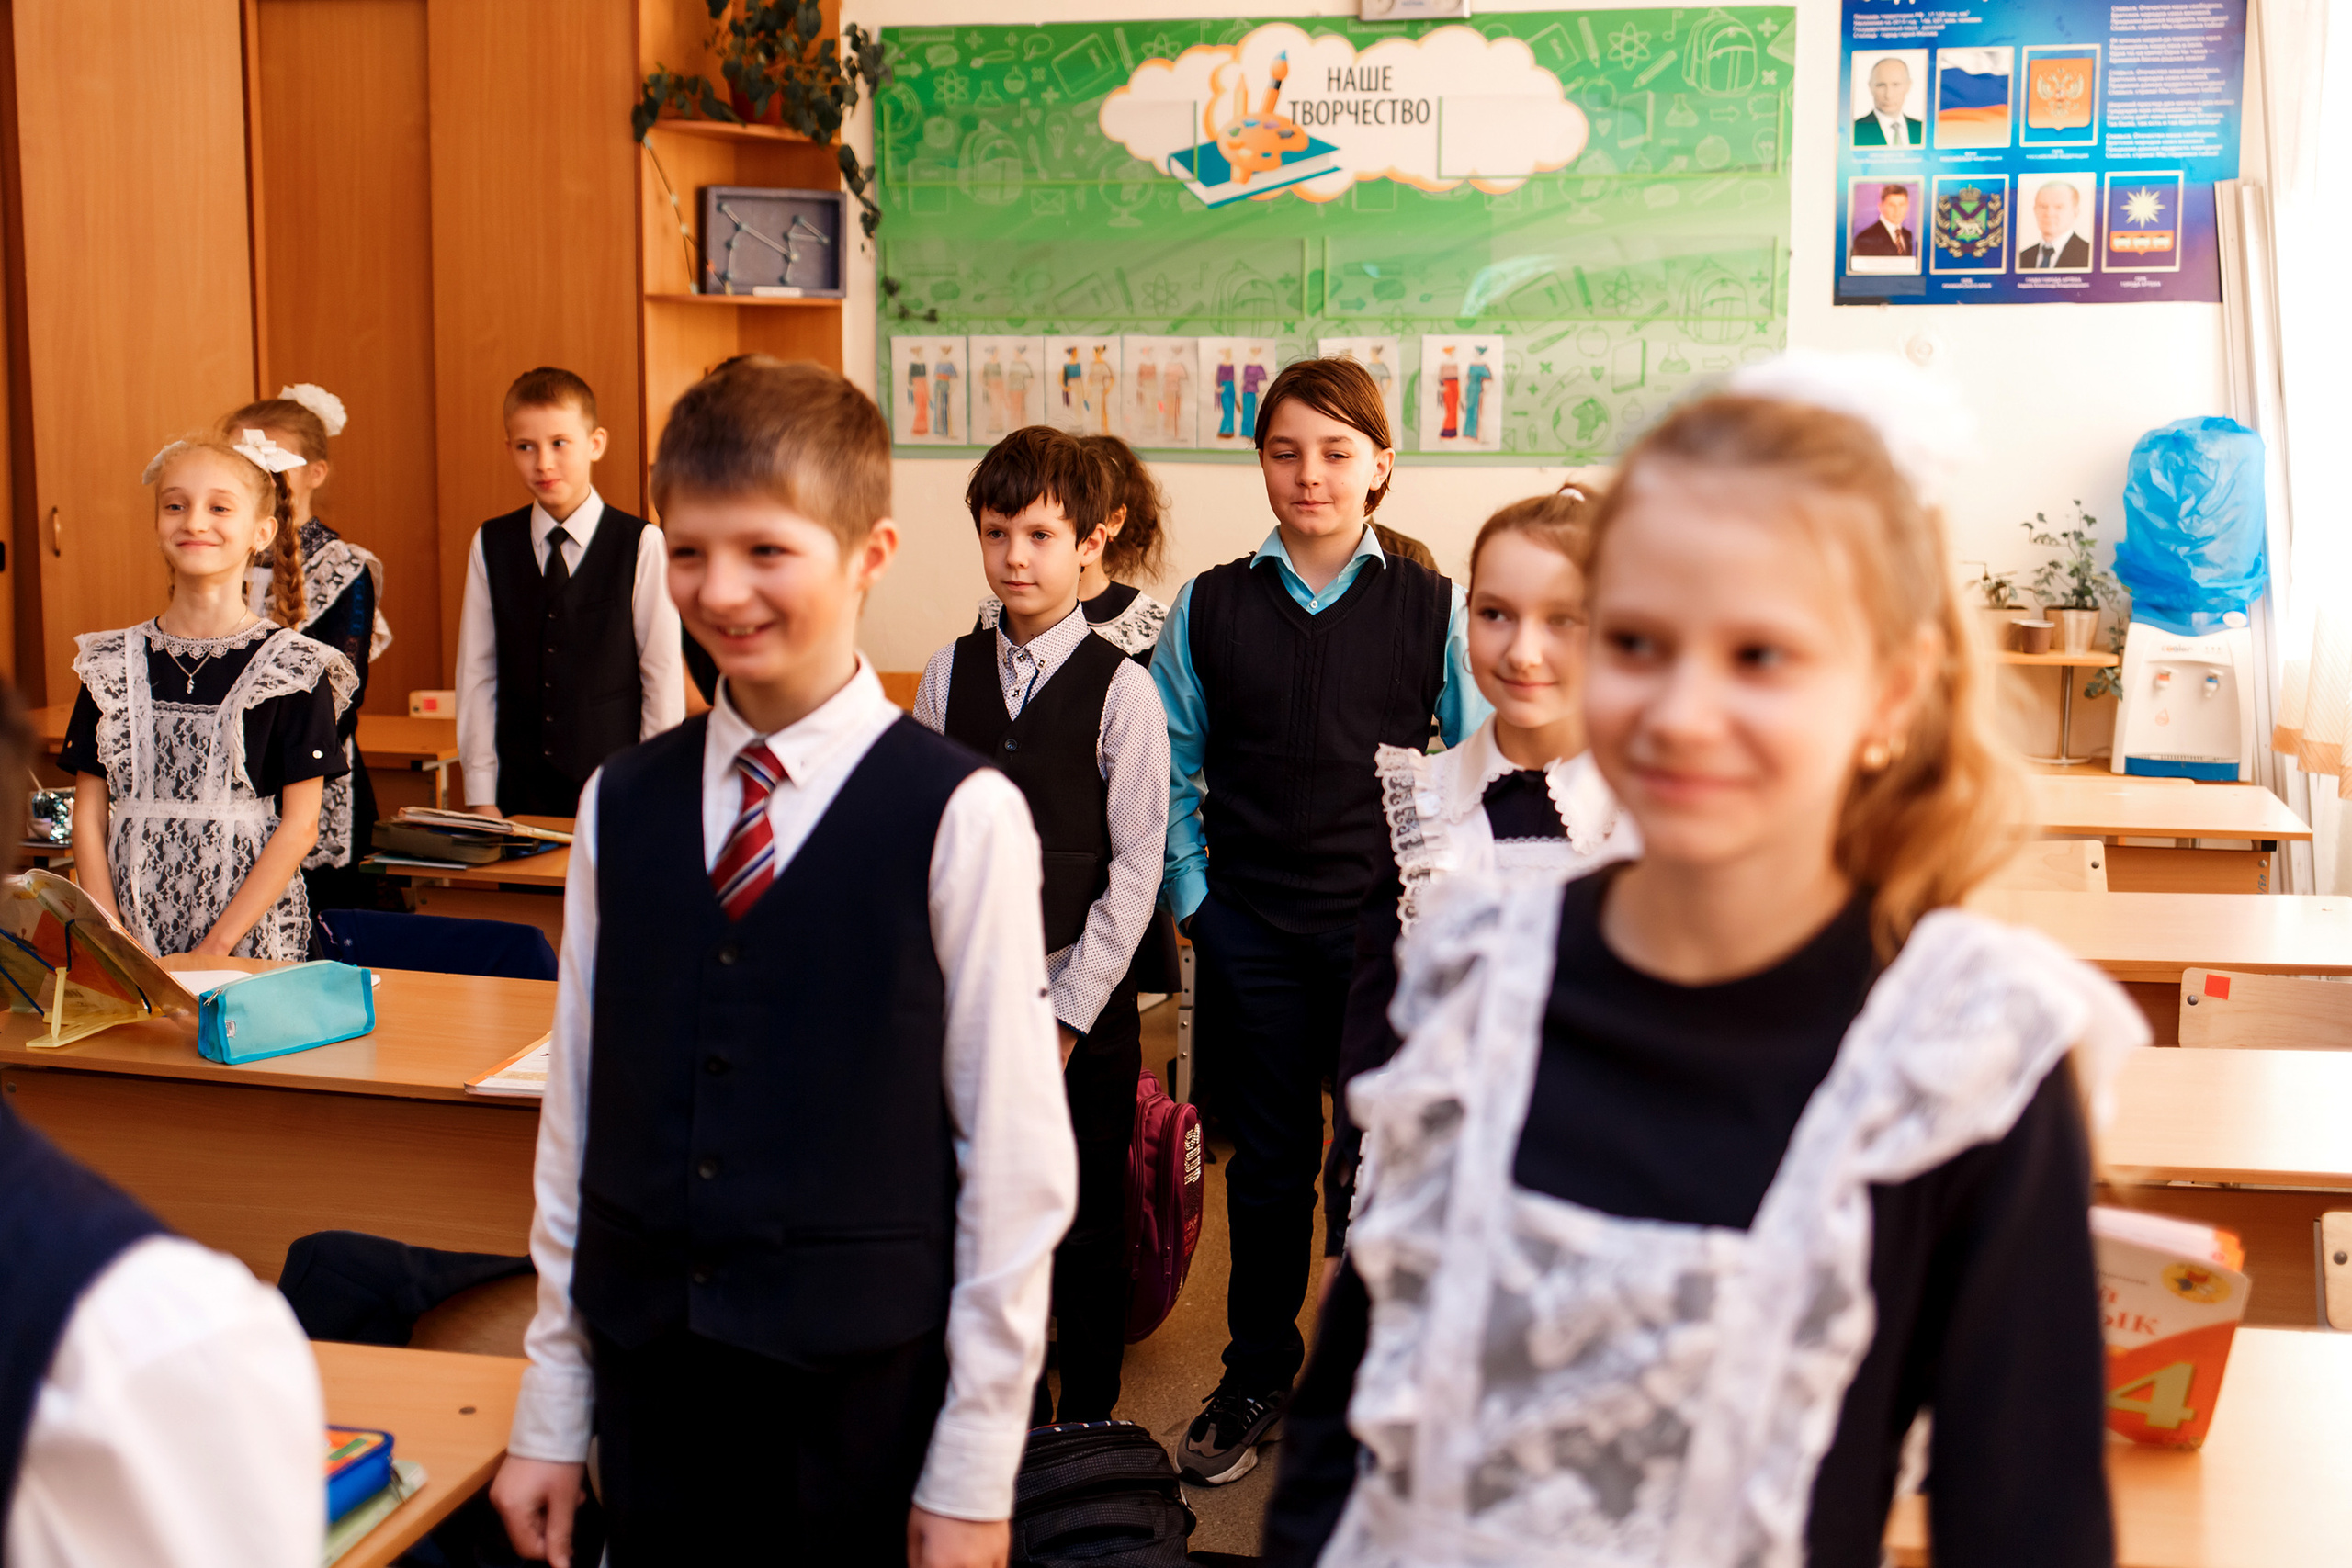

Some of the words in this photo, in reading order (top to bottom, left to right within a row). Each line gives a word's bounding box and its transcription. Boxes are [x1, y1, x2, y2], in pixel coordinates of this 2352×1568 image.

[1327, 65, 1393, 92] НАШЕ
[1288, 98, 1430, 126] ТВОРЧЕСТВО
[2103, 1360, 2196, 1430] 4
